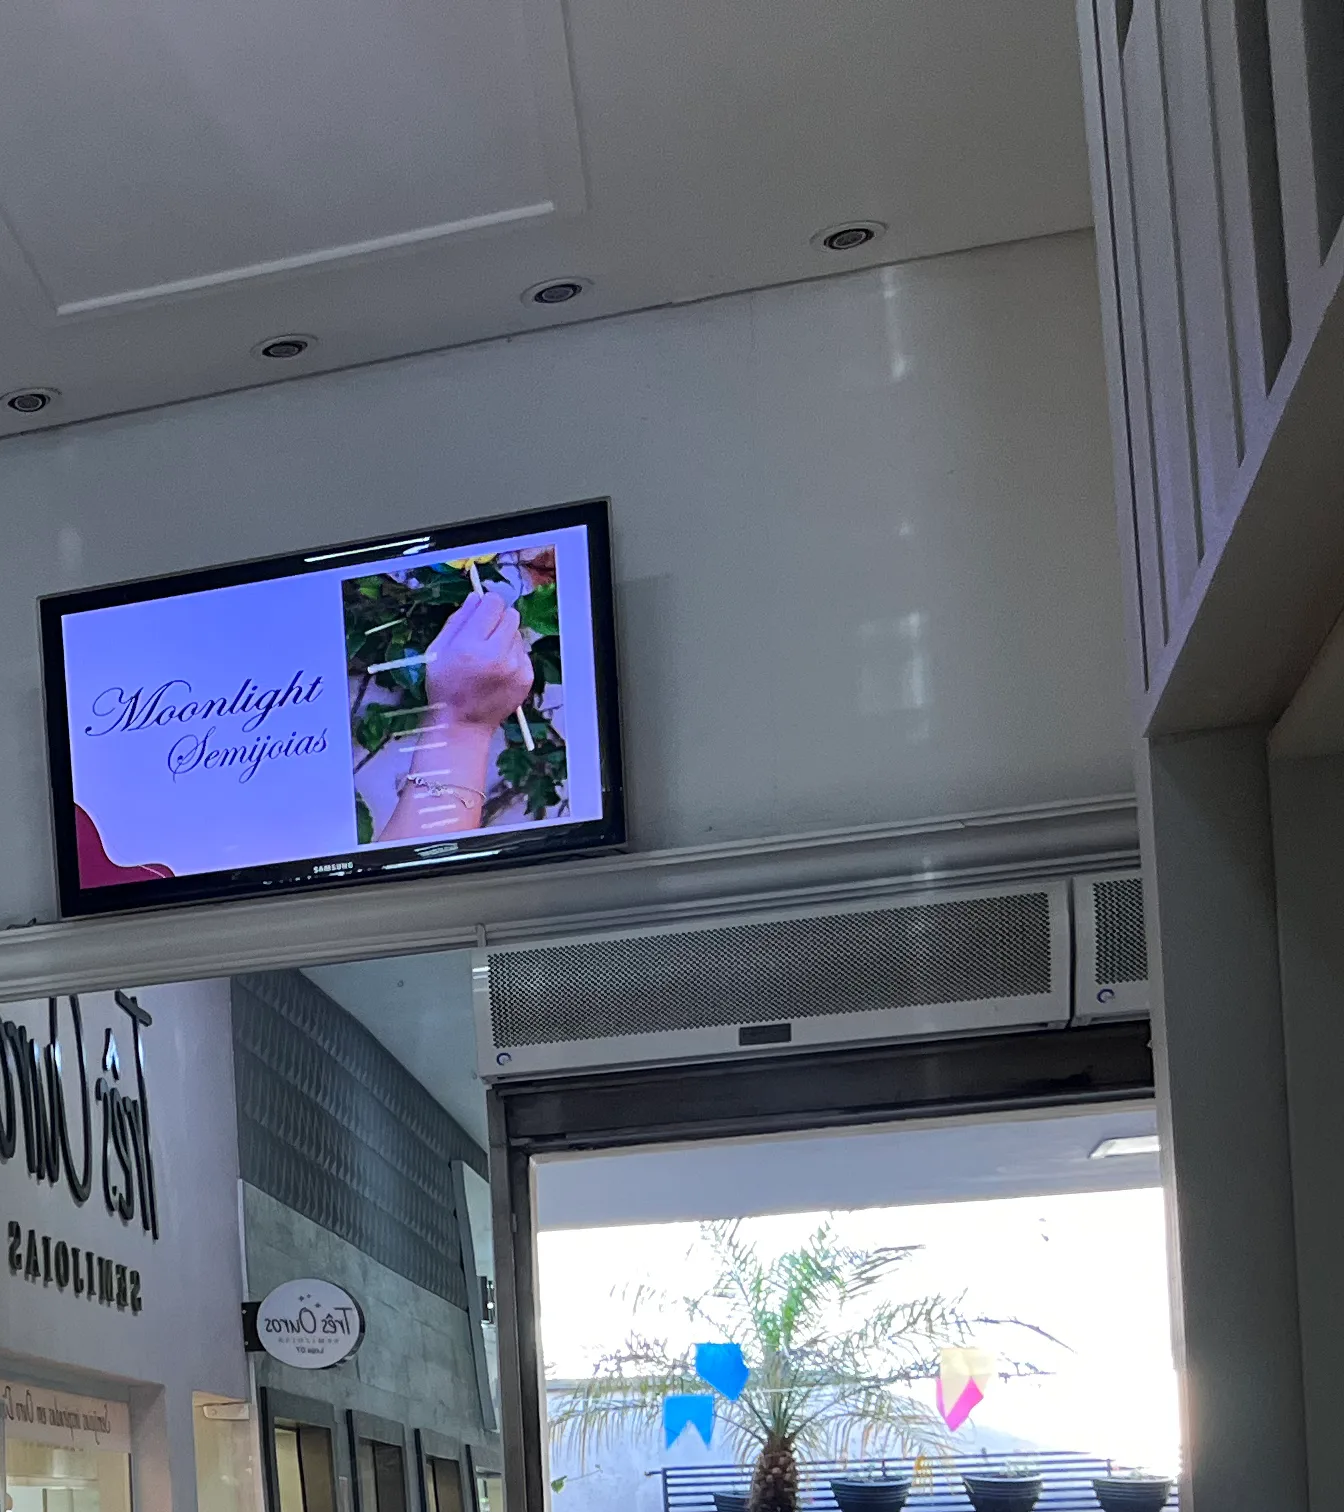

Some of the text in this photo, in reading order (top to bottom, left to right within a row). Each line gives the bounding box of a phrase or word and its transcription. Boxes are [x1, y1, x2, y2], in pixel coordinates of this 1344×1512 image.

[84, 669, 325, 737] Moonlight
[166, 725, 329, 784] Semijoias
[313, 861, 354, 874] SAMSUNG
